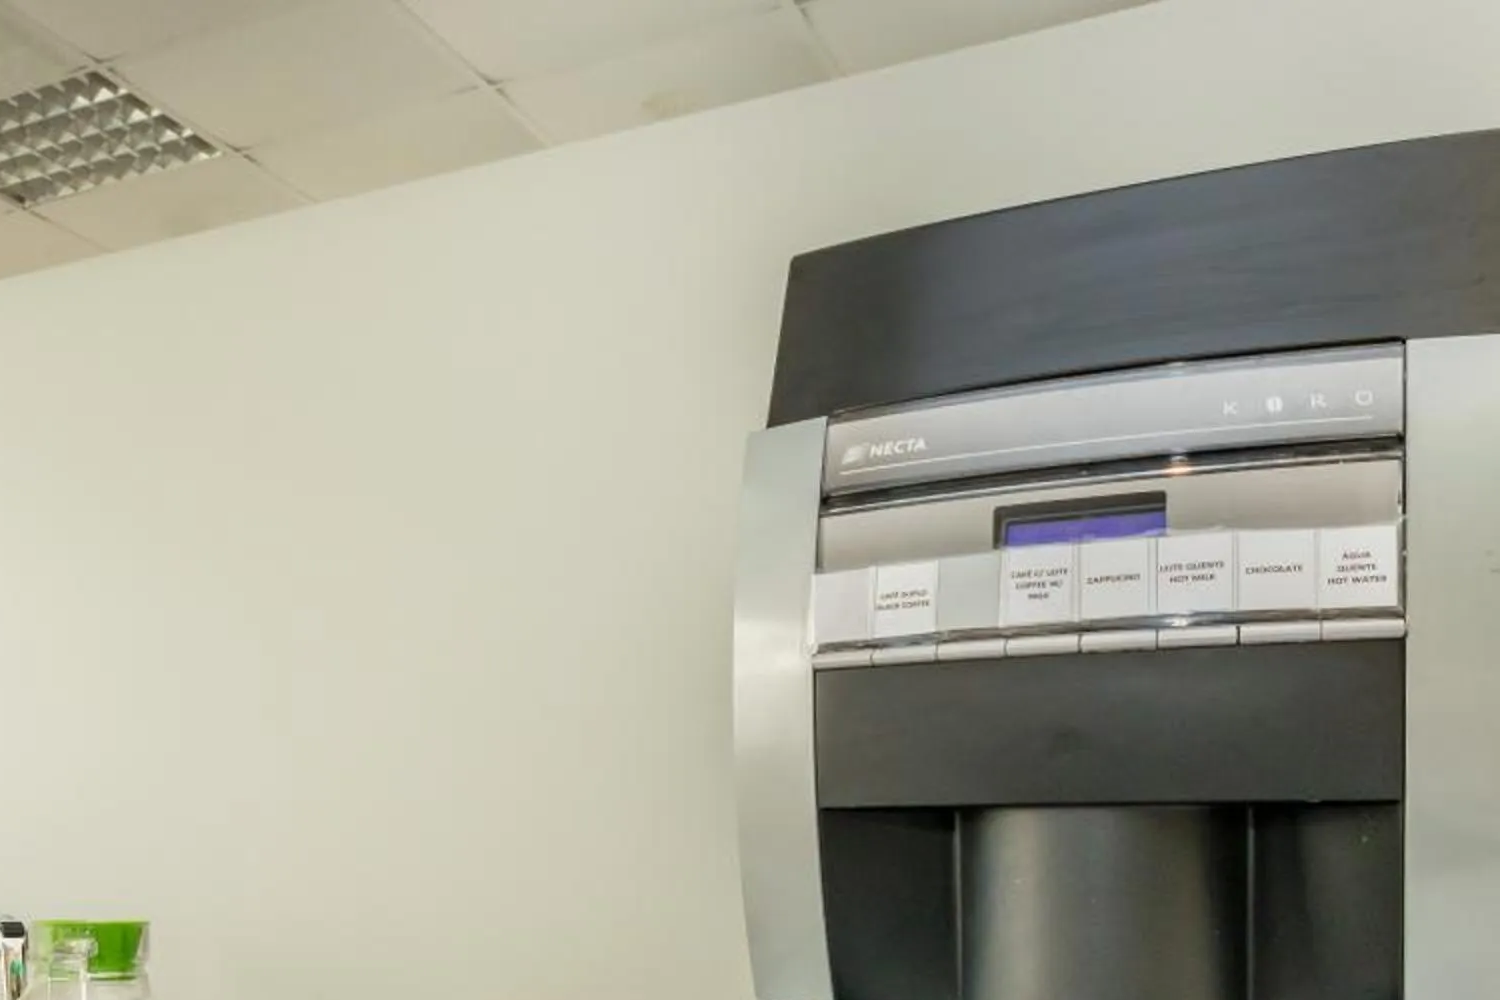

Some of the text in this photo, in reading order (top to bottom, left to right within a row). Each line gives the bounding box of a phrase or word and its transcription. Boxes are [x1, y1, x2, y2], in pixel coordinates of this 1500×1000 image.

[869, 437, 926, 458] NECTA
[1245, 563, 1303, 575] CHOCOLATE
[1169, 574, 1189, 584] HOT
[1327, 574, 1388, 585] HOT WATER
